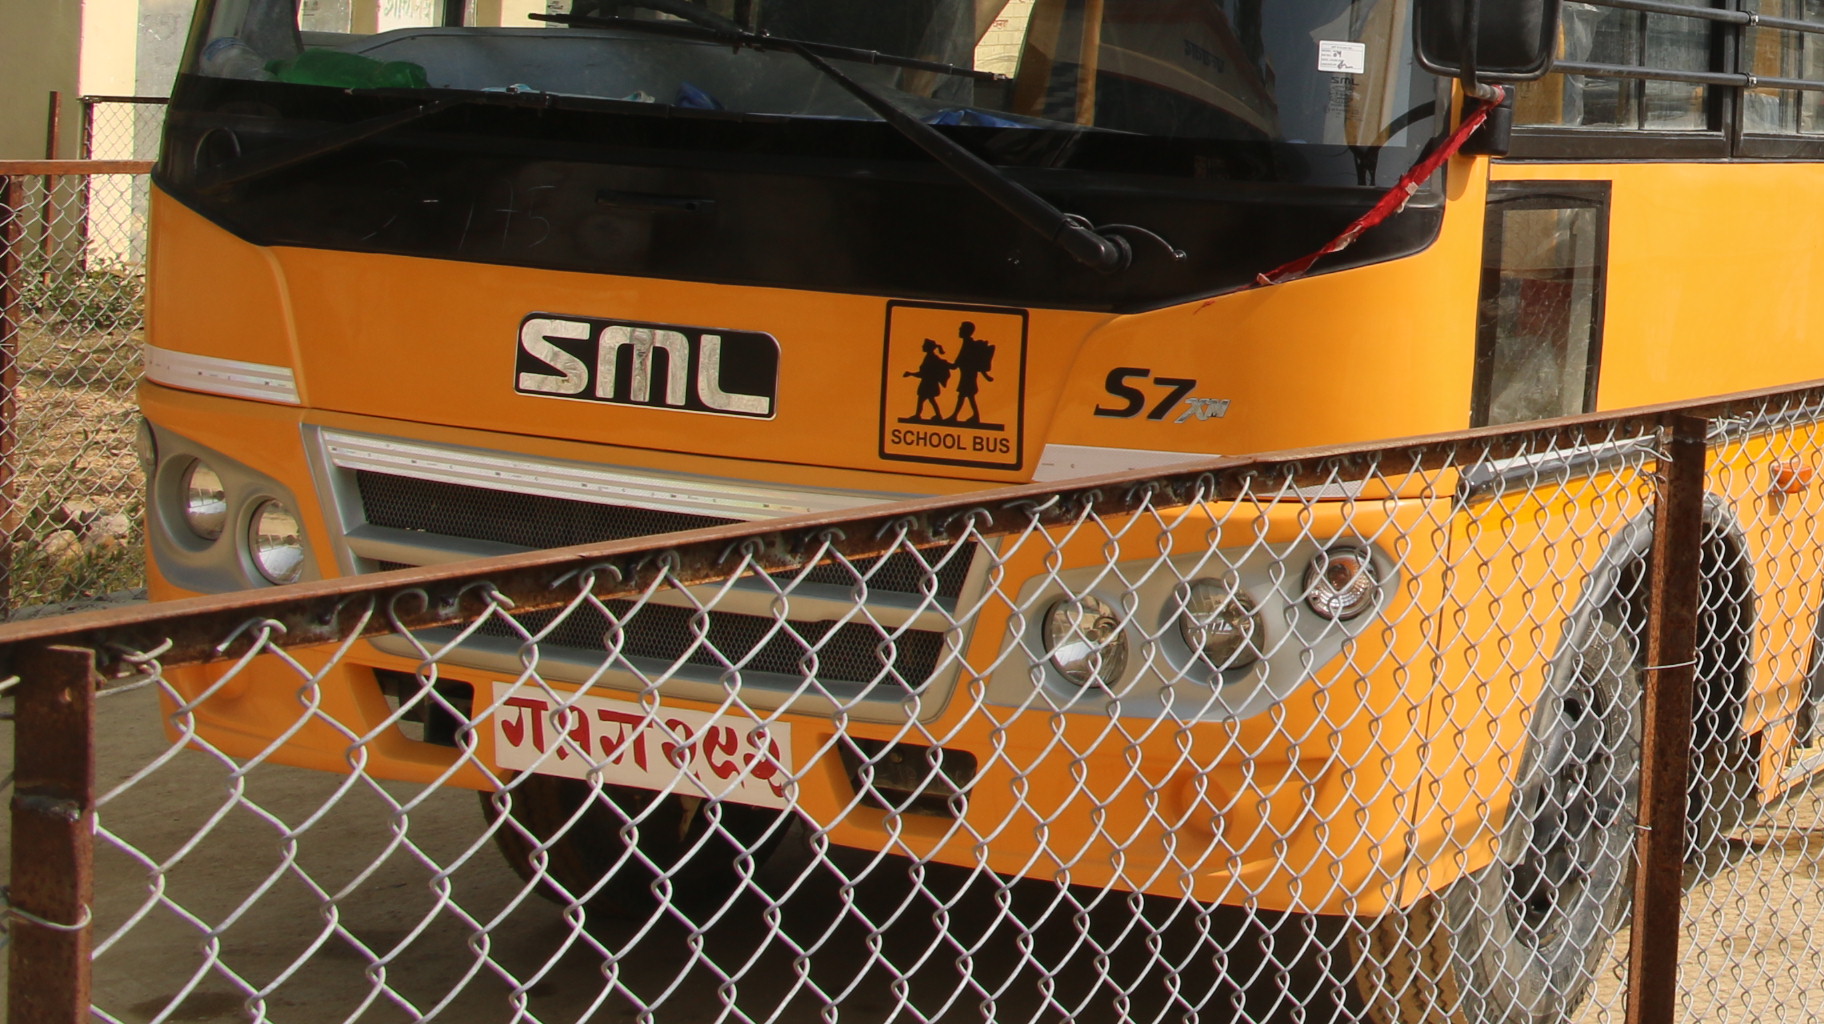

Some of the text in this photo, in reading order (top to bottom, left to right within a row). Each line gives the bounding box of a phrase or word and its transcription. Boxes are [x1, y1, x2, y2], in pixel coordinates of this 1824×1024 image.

[1331, 76, 1360, 86] SML
[518, 317, 771, 415] SML
[889, 428, 1010, 456] SCHOOL BUS
